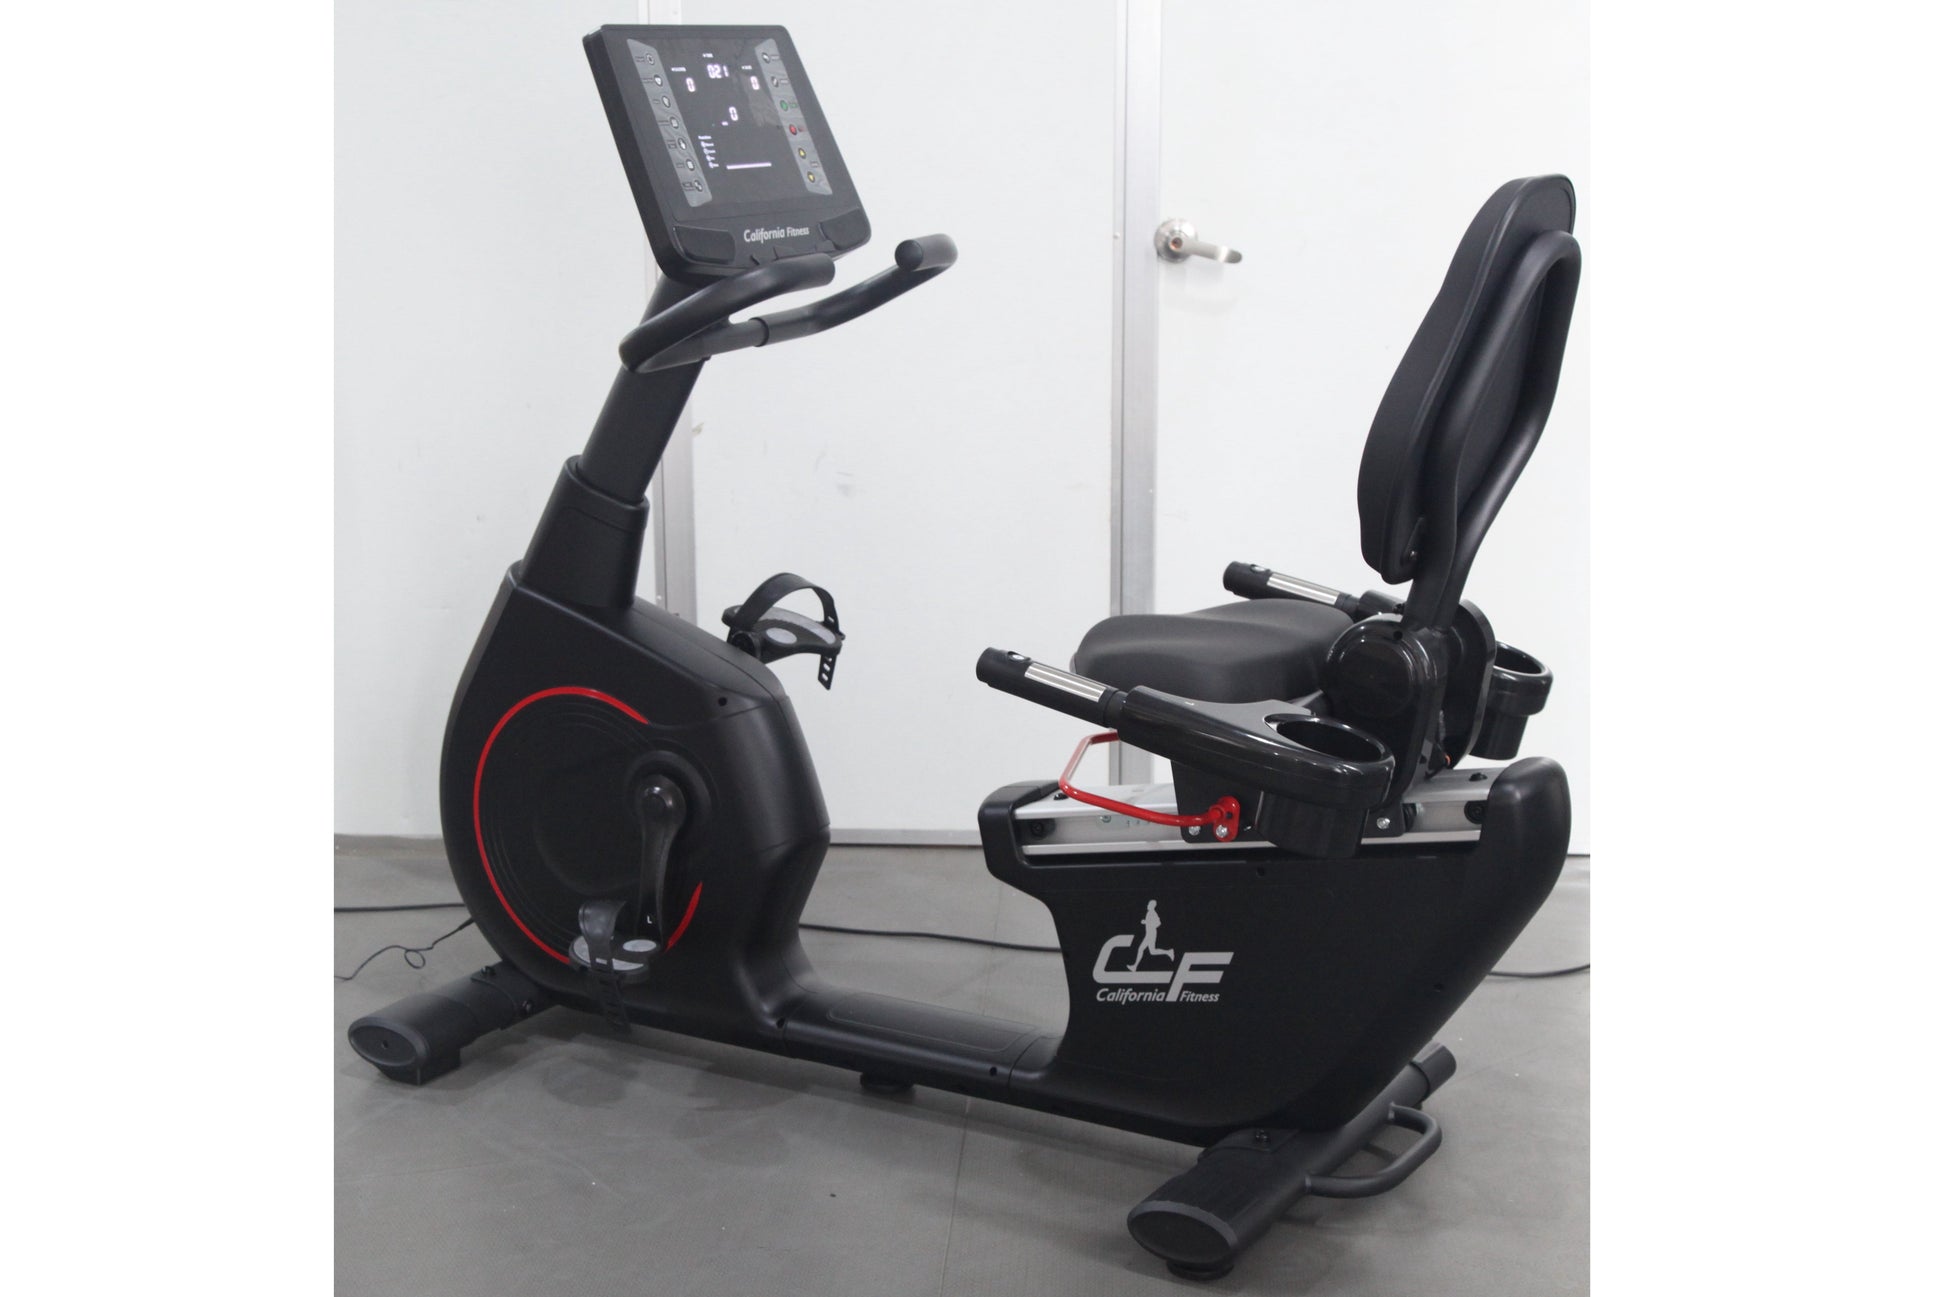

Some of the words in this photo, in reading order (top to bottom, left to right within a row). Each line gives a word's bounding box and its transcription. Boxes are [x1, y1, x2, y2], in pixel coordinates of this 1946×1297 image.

[743, 226, 785, 244] California
[786, 226, 809, 237] Fitness
[1096, 987, 1166, 1005] California
[1179, 990, 1220, 1002] Fitness
